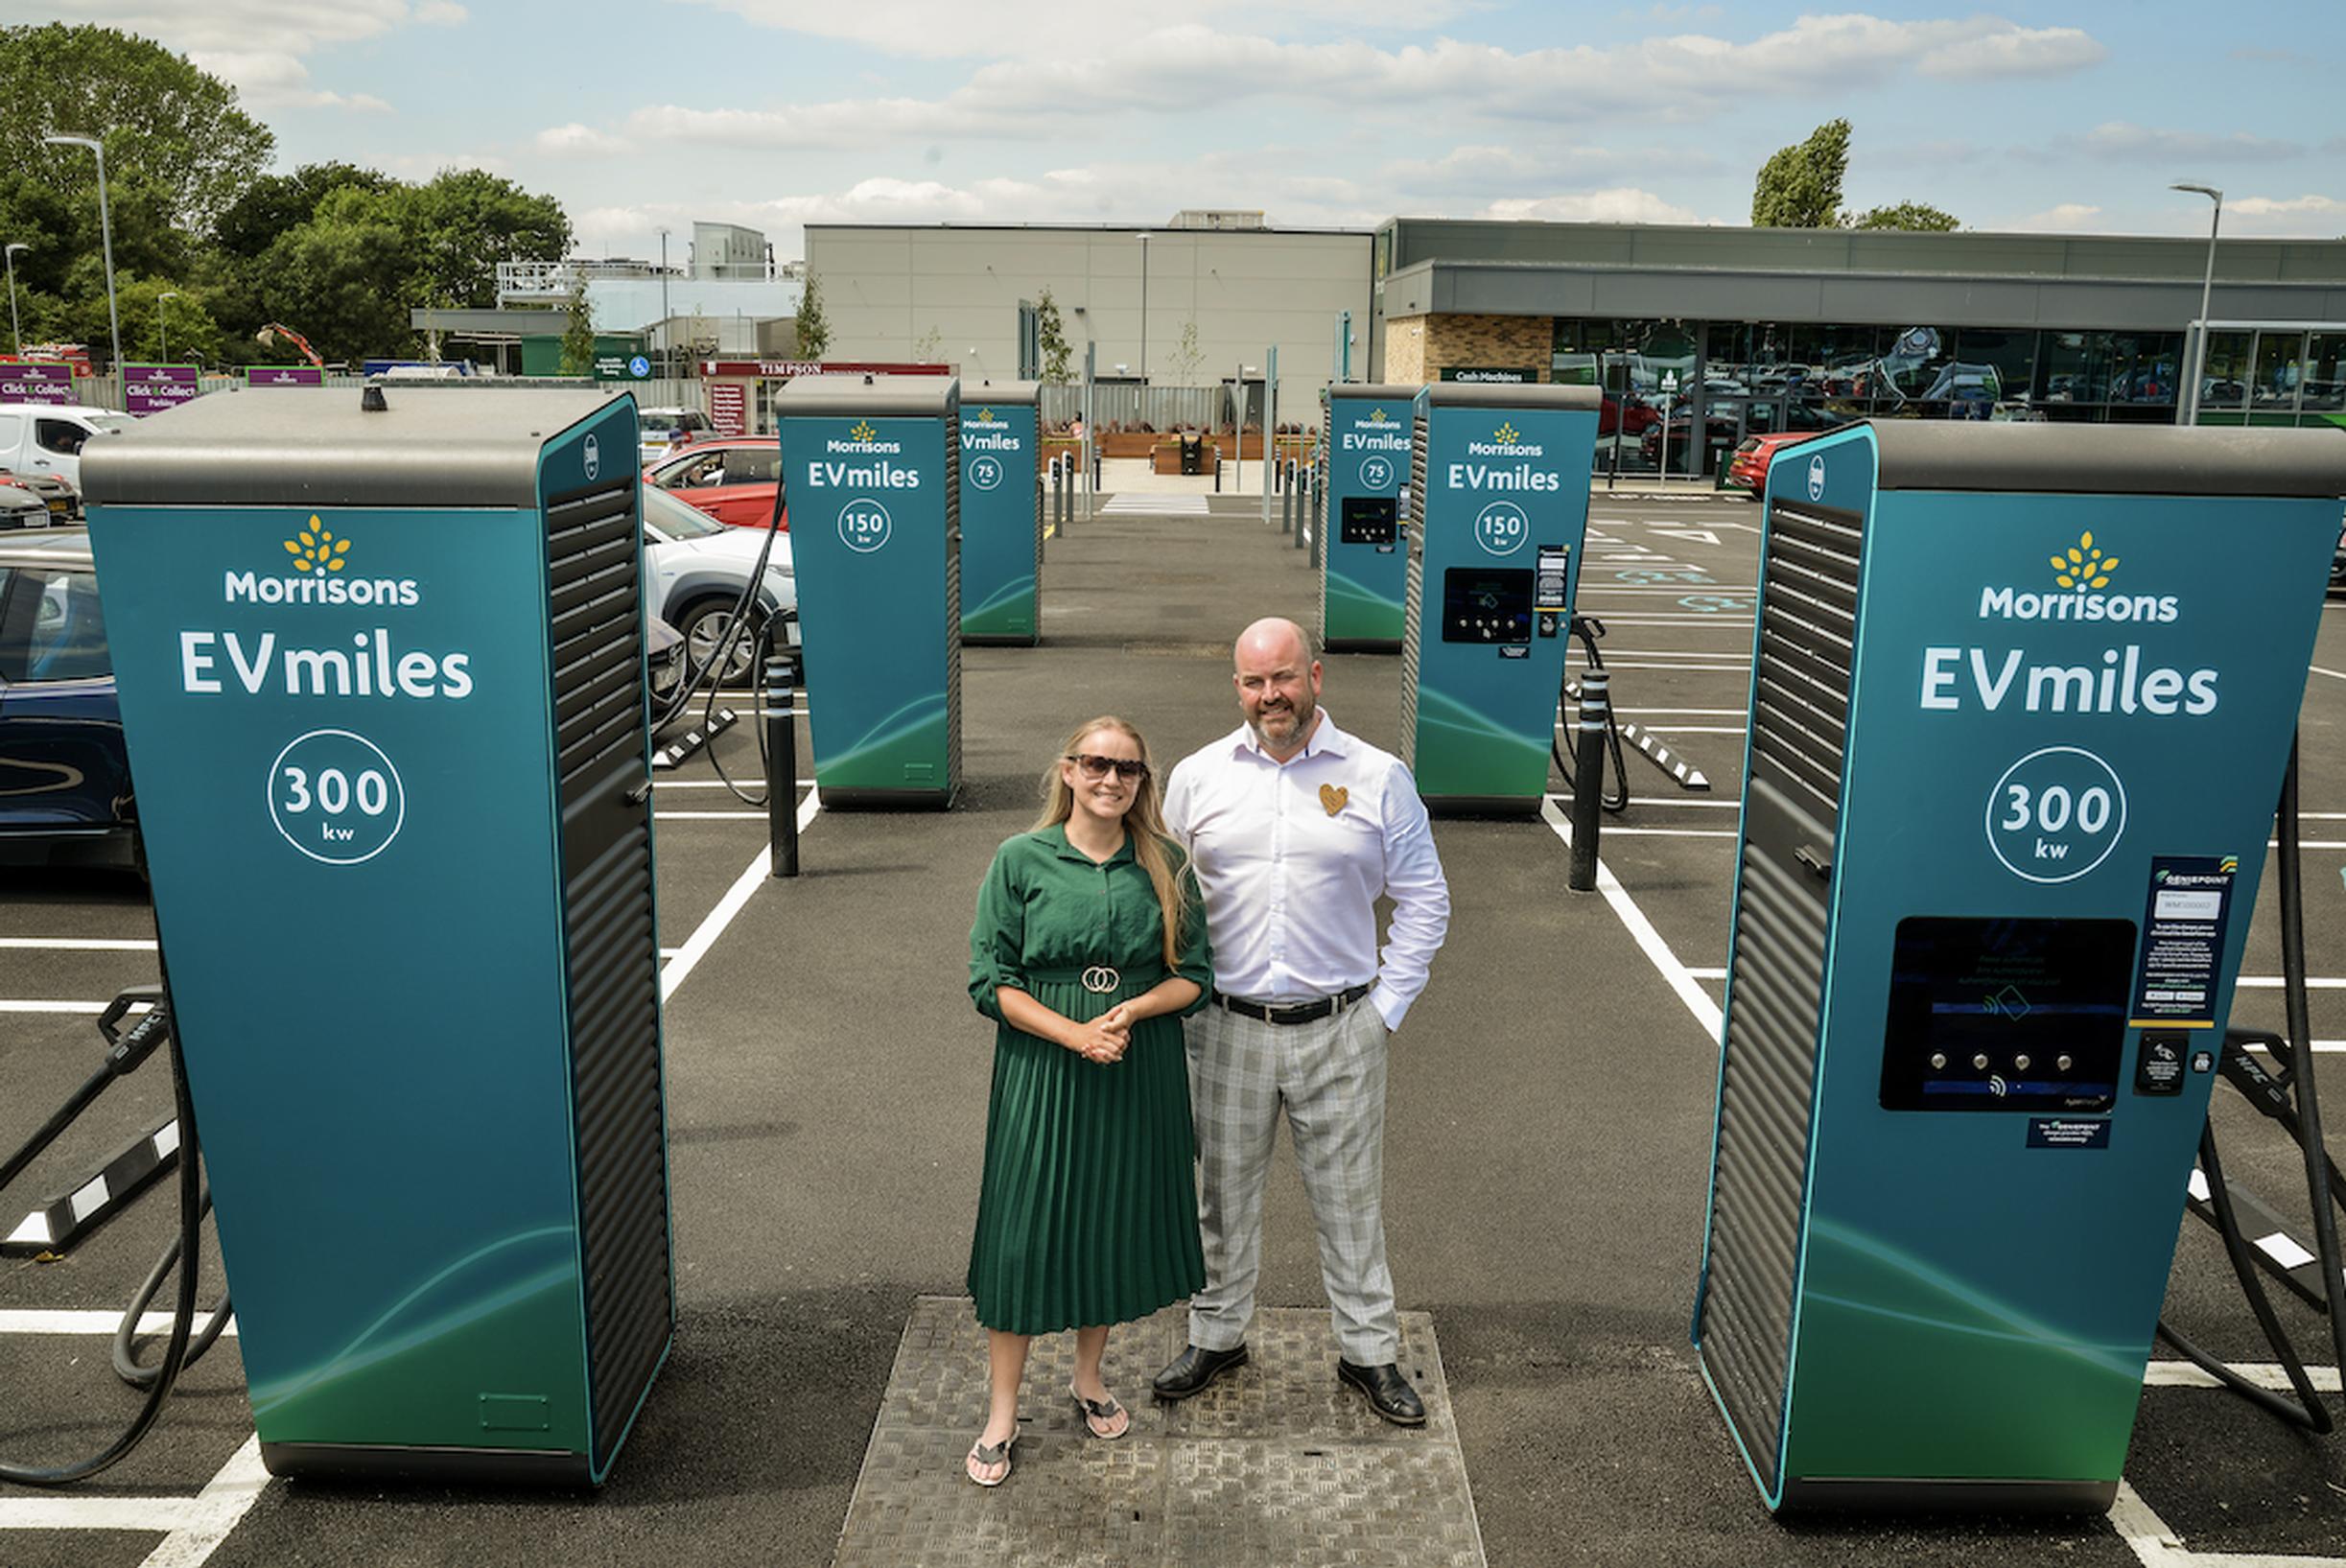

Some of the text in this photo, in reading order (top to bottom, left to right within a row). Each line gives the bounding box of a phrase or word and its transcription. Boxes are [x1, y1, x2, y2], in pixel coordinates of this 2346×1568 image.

[760, 363, 822, 375] TIMPSON
[1456, 371, 1478, 382] Cash
[2, 384, 27, 394] Click
[127, 385, 152, 396] Click
[160, 385, 196, 396] Collect
[827, 438, 901, 454] Morrisons
[958, 433, 1021, 451] Vmiles
[1467, 441, 1543, 456] Morrisons
[978, 464, 995, 478] 75
[1369, 464, 1385, 478] 75
[846, 513, 883, 532] 150
[1483, 515, 1521, 535] 150
[224, 567, 420, 606] Morrisons
[1979, 583, 2179, 623] Morrisons
[284, 766, 388, 815] 300
[2002, 784, 2111, 834] 300
[322, 822, 354, 840] kw
[2034, 837, 2069, 859] kw
